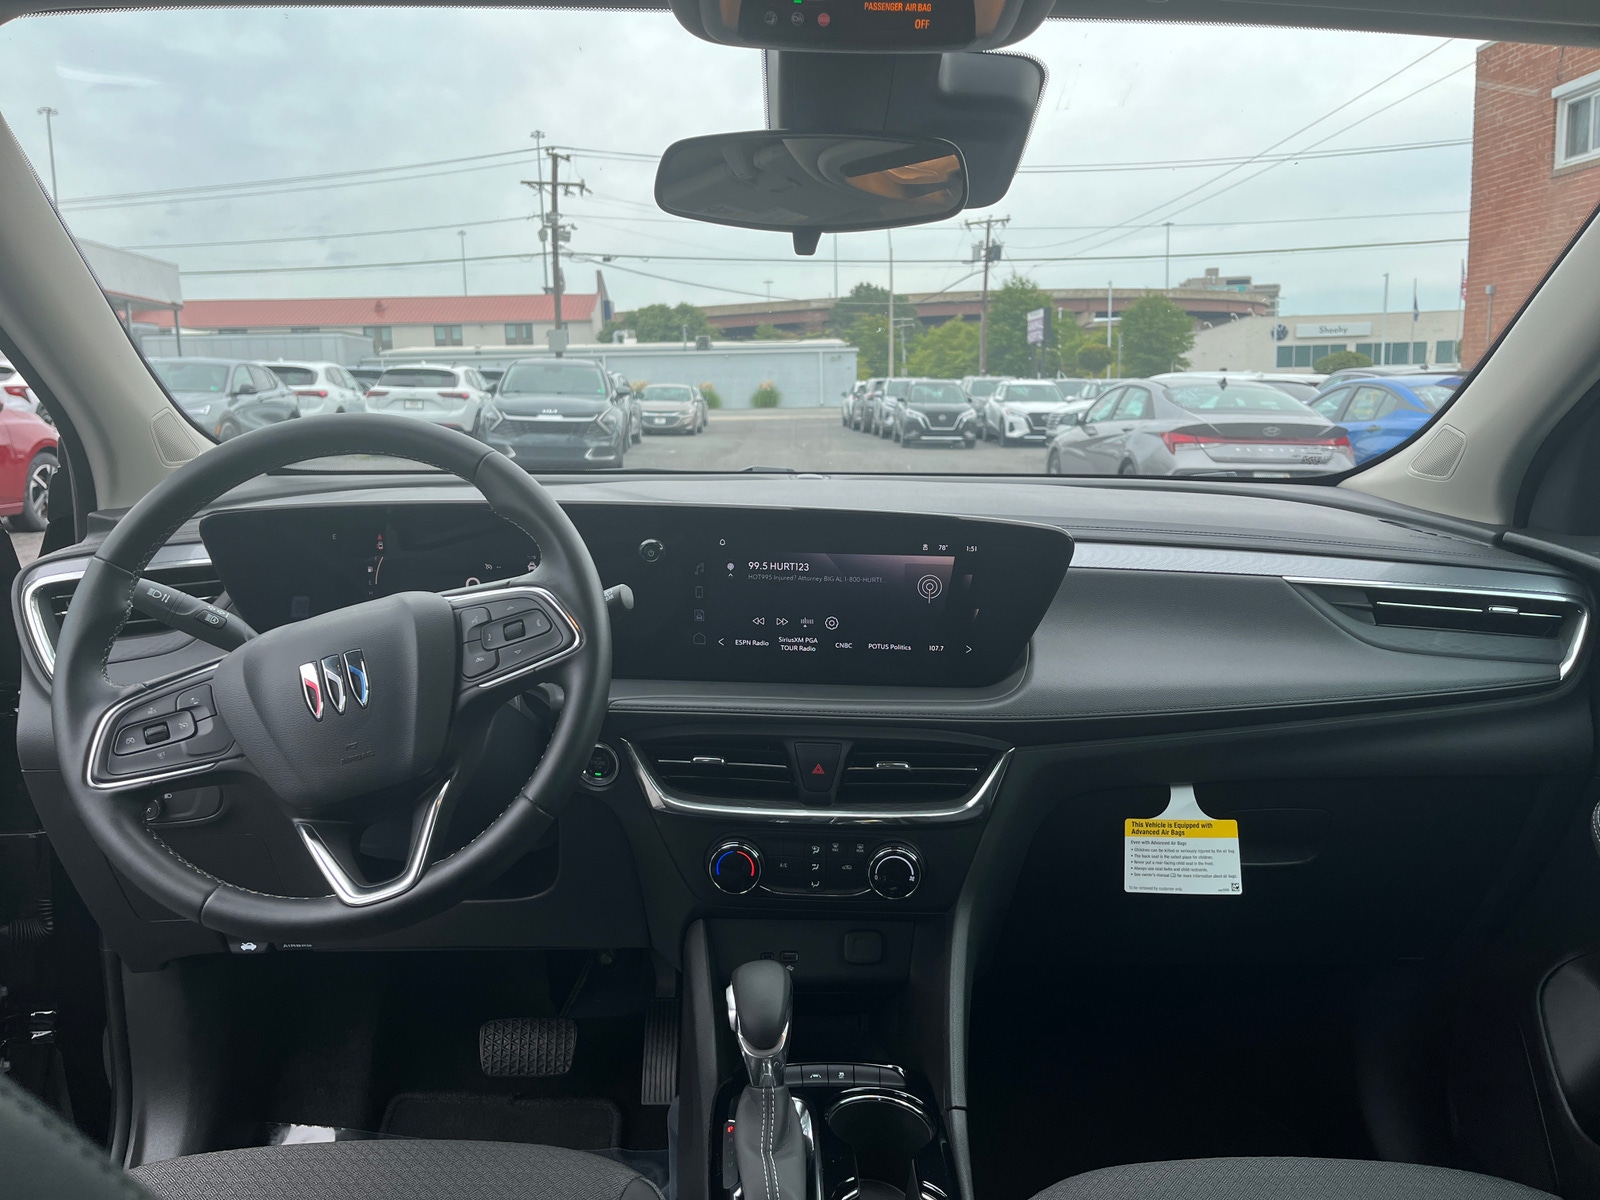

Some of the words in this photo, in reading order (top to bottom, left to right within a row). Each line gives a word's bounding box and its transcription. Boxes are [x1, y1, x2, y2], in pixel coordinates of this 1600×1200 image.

[864, 2, 903, 11] PASSENGER
[905, 3, 916, 11] AIR
[918, 3, 931, 12] BAG
[915, 19, 930, 29] OFF
[748, 561, 768, 570] 99.5
[770, 562, 810, 571] HURT123
[798, 575, 822, 583] Attorney
[778, 636, 804, 644] SiriusXM
